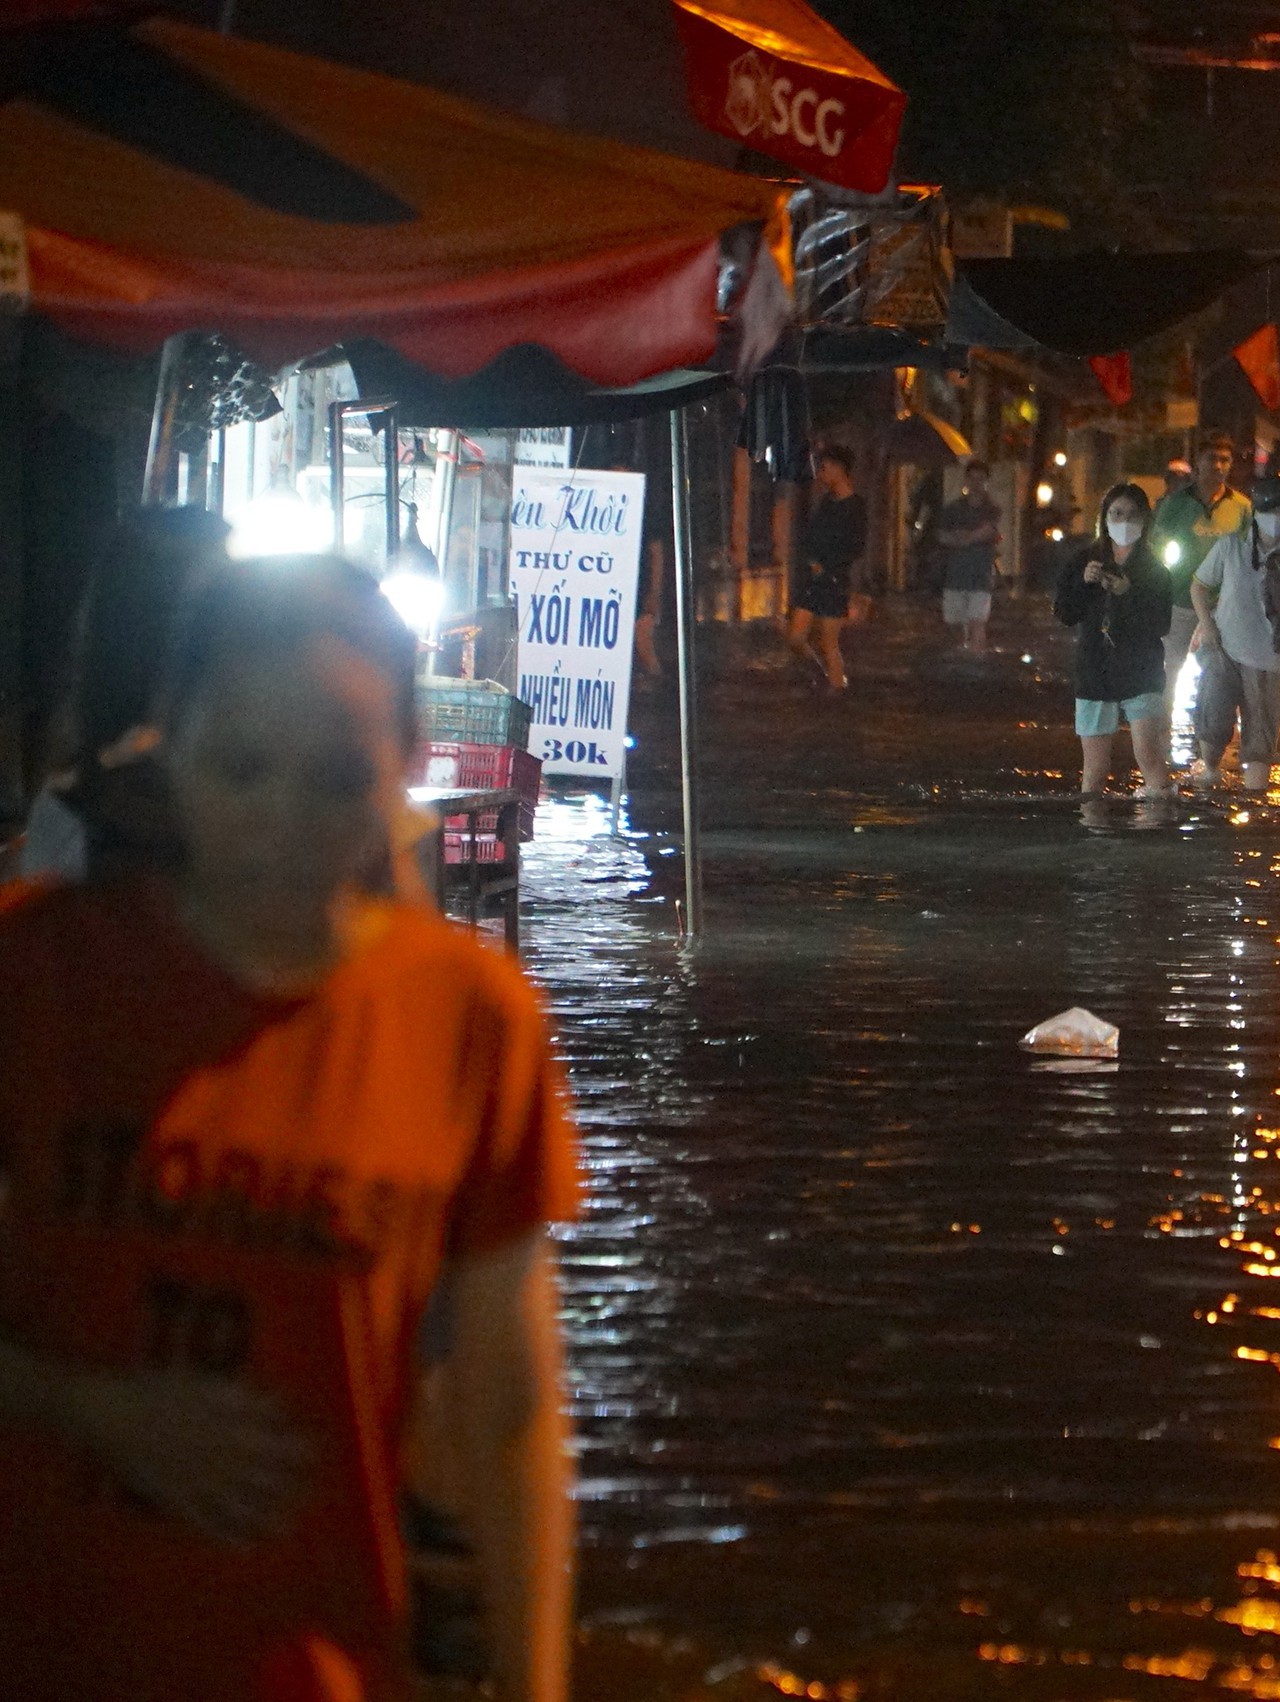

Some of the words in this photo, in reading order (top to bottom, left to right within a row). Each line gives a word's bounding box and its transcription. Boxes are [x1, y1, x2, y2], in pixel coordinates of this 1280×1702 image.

[516, 549, 573, 571] THƯ
[577, 551, 615, 573] CŨ
[527, 579, 572, 645] XỐI
[577, 588, 623, 650] MỠ
[520, 659, 571, 728] NHIỀU
[573, 668, 615, 731] MÓN
[541, 738, 609, 766] 30k
